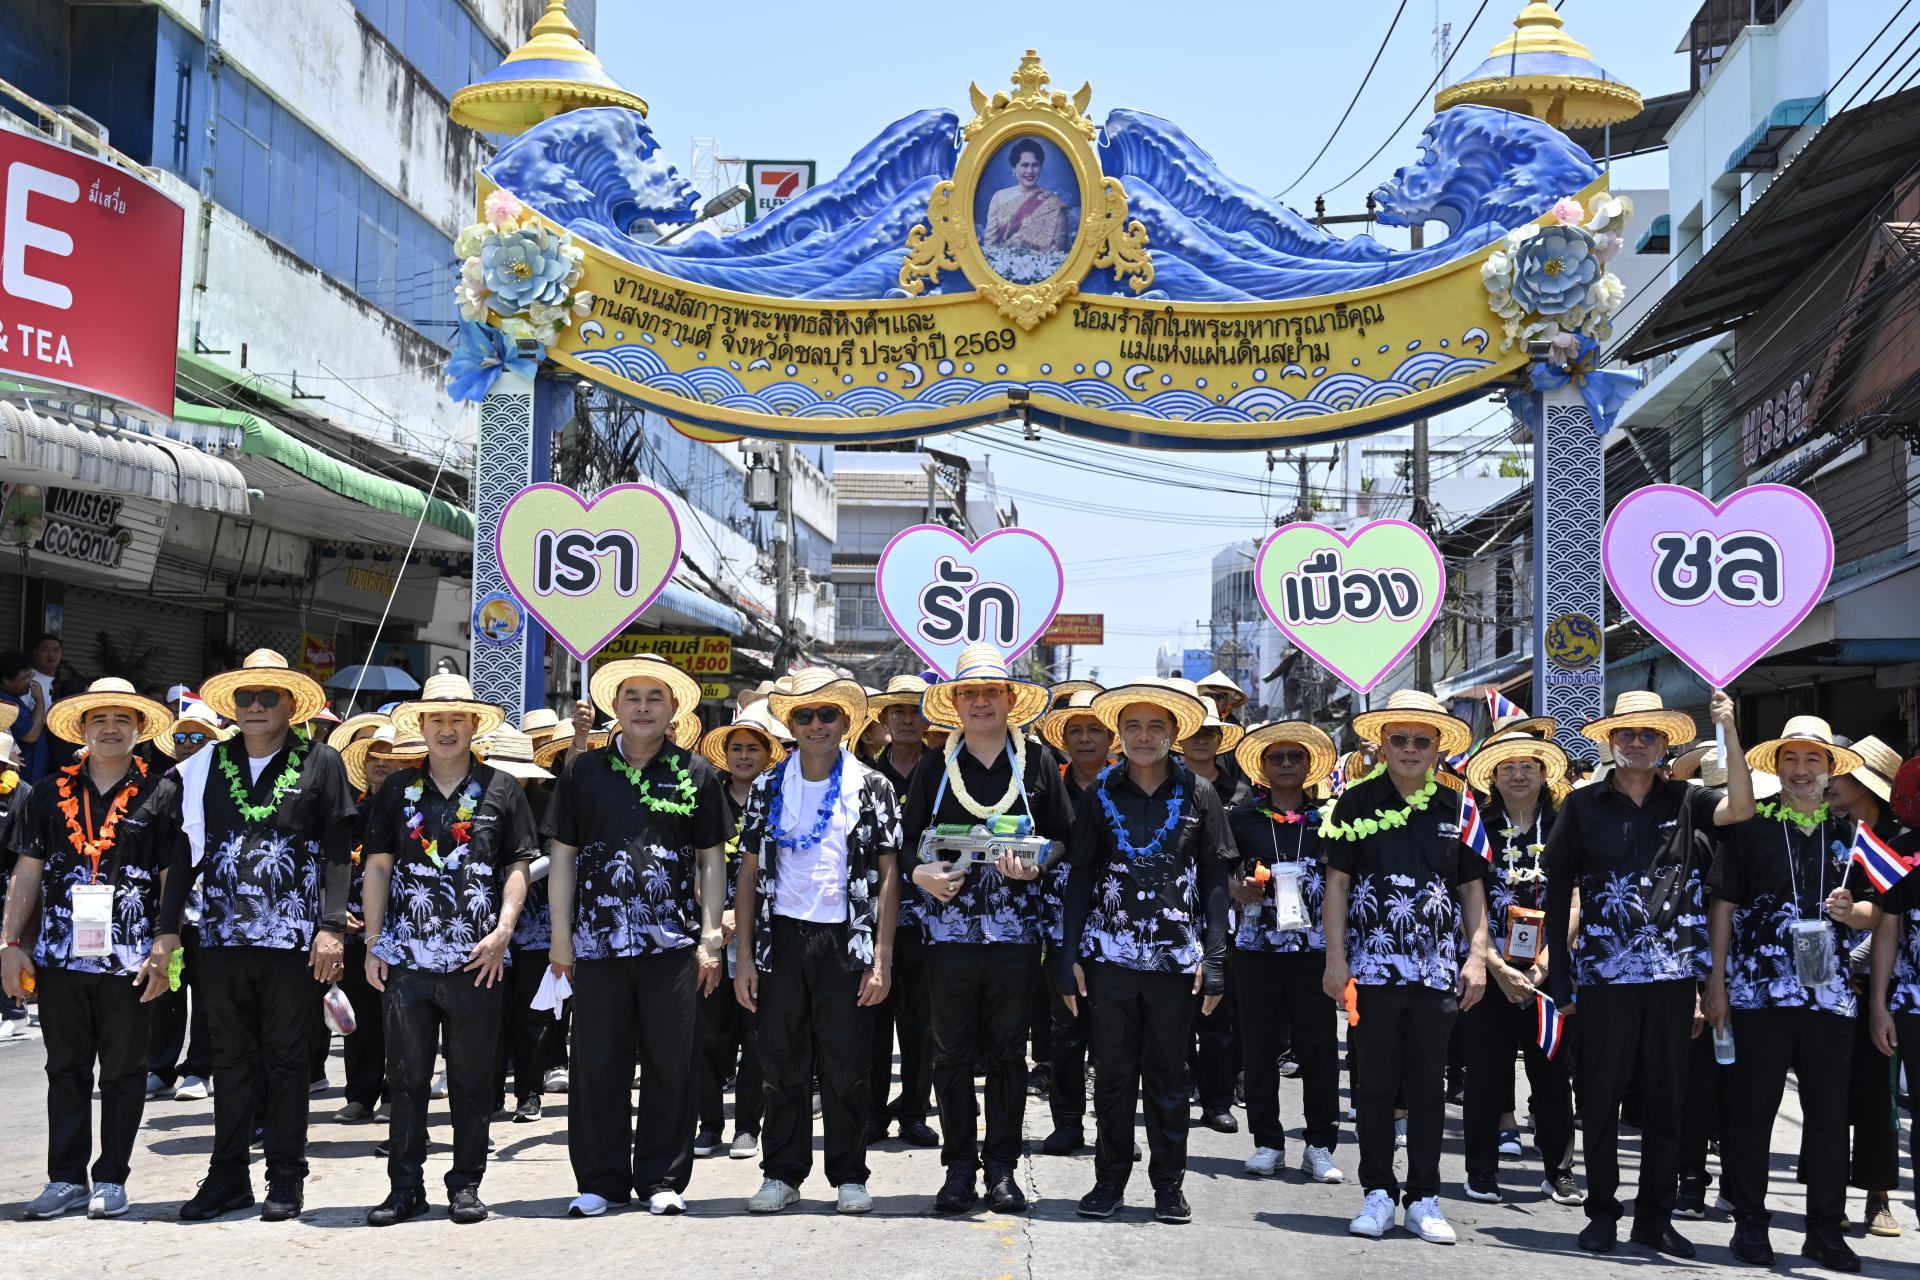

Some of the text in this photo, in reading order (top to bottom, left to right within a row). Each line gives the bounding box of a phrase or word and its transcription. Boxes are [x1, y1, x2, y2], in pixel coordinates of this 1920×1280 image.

[761, 172, 799, 197] 7
[590, 294, 1016, 376] งานสงกรานต์ จังหวัดชลบุรี ประจำปี 2569
[612, 276, 936, 342] งานนมัสการพระพุทธสิหิงค์ฯและ
[1073, 301, 1385, 346] น้อมรำลึกในพระมหากรุณาธิคุณ
[17, 323, 74, 368] TEA
[1119, 338, 1330, 366] แม่แห่งแผ่นดินสยาม
[538, 533, 634, 592] เรา
[1285, 552, 1419, 621] เมือง
[1657, 535, 1778, 601] ชล
[922, 560, 1015, 643] รัก
